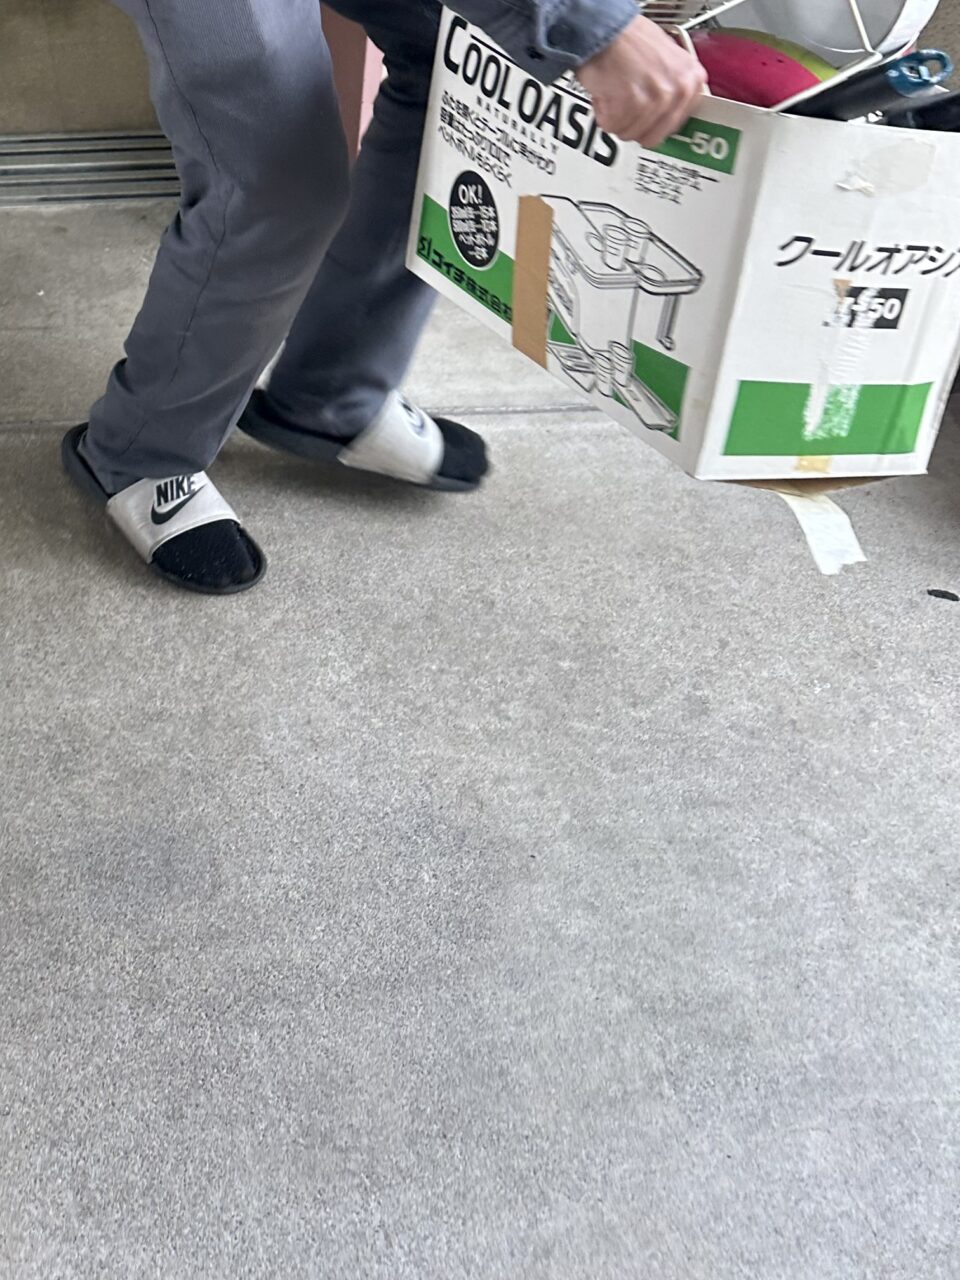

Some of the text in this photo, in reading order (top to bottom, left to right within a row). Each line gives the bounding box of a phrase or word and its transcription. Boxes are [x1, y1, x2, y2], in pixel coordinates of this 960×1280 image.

[443, 15, 512, 111] COOL
[518, 78, 618, 168] OASIS
[477, 95, 559, 155] NATURALLY
[458, 184, 483, 204] OK!
[155, 474, 197, 508] NIKE
